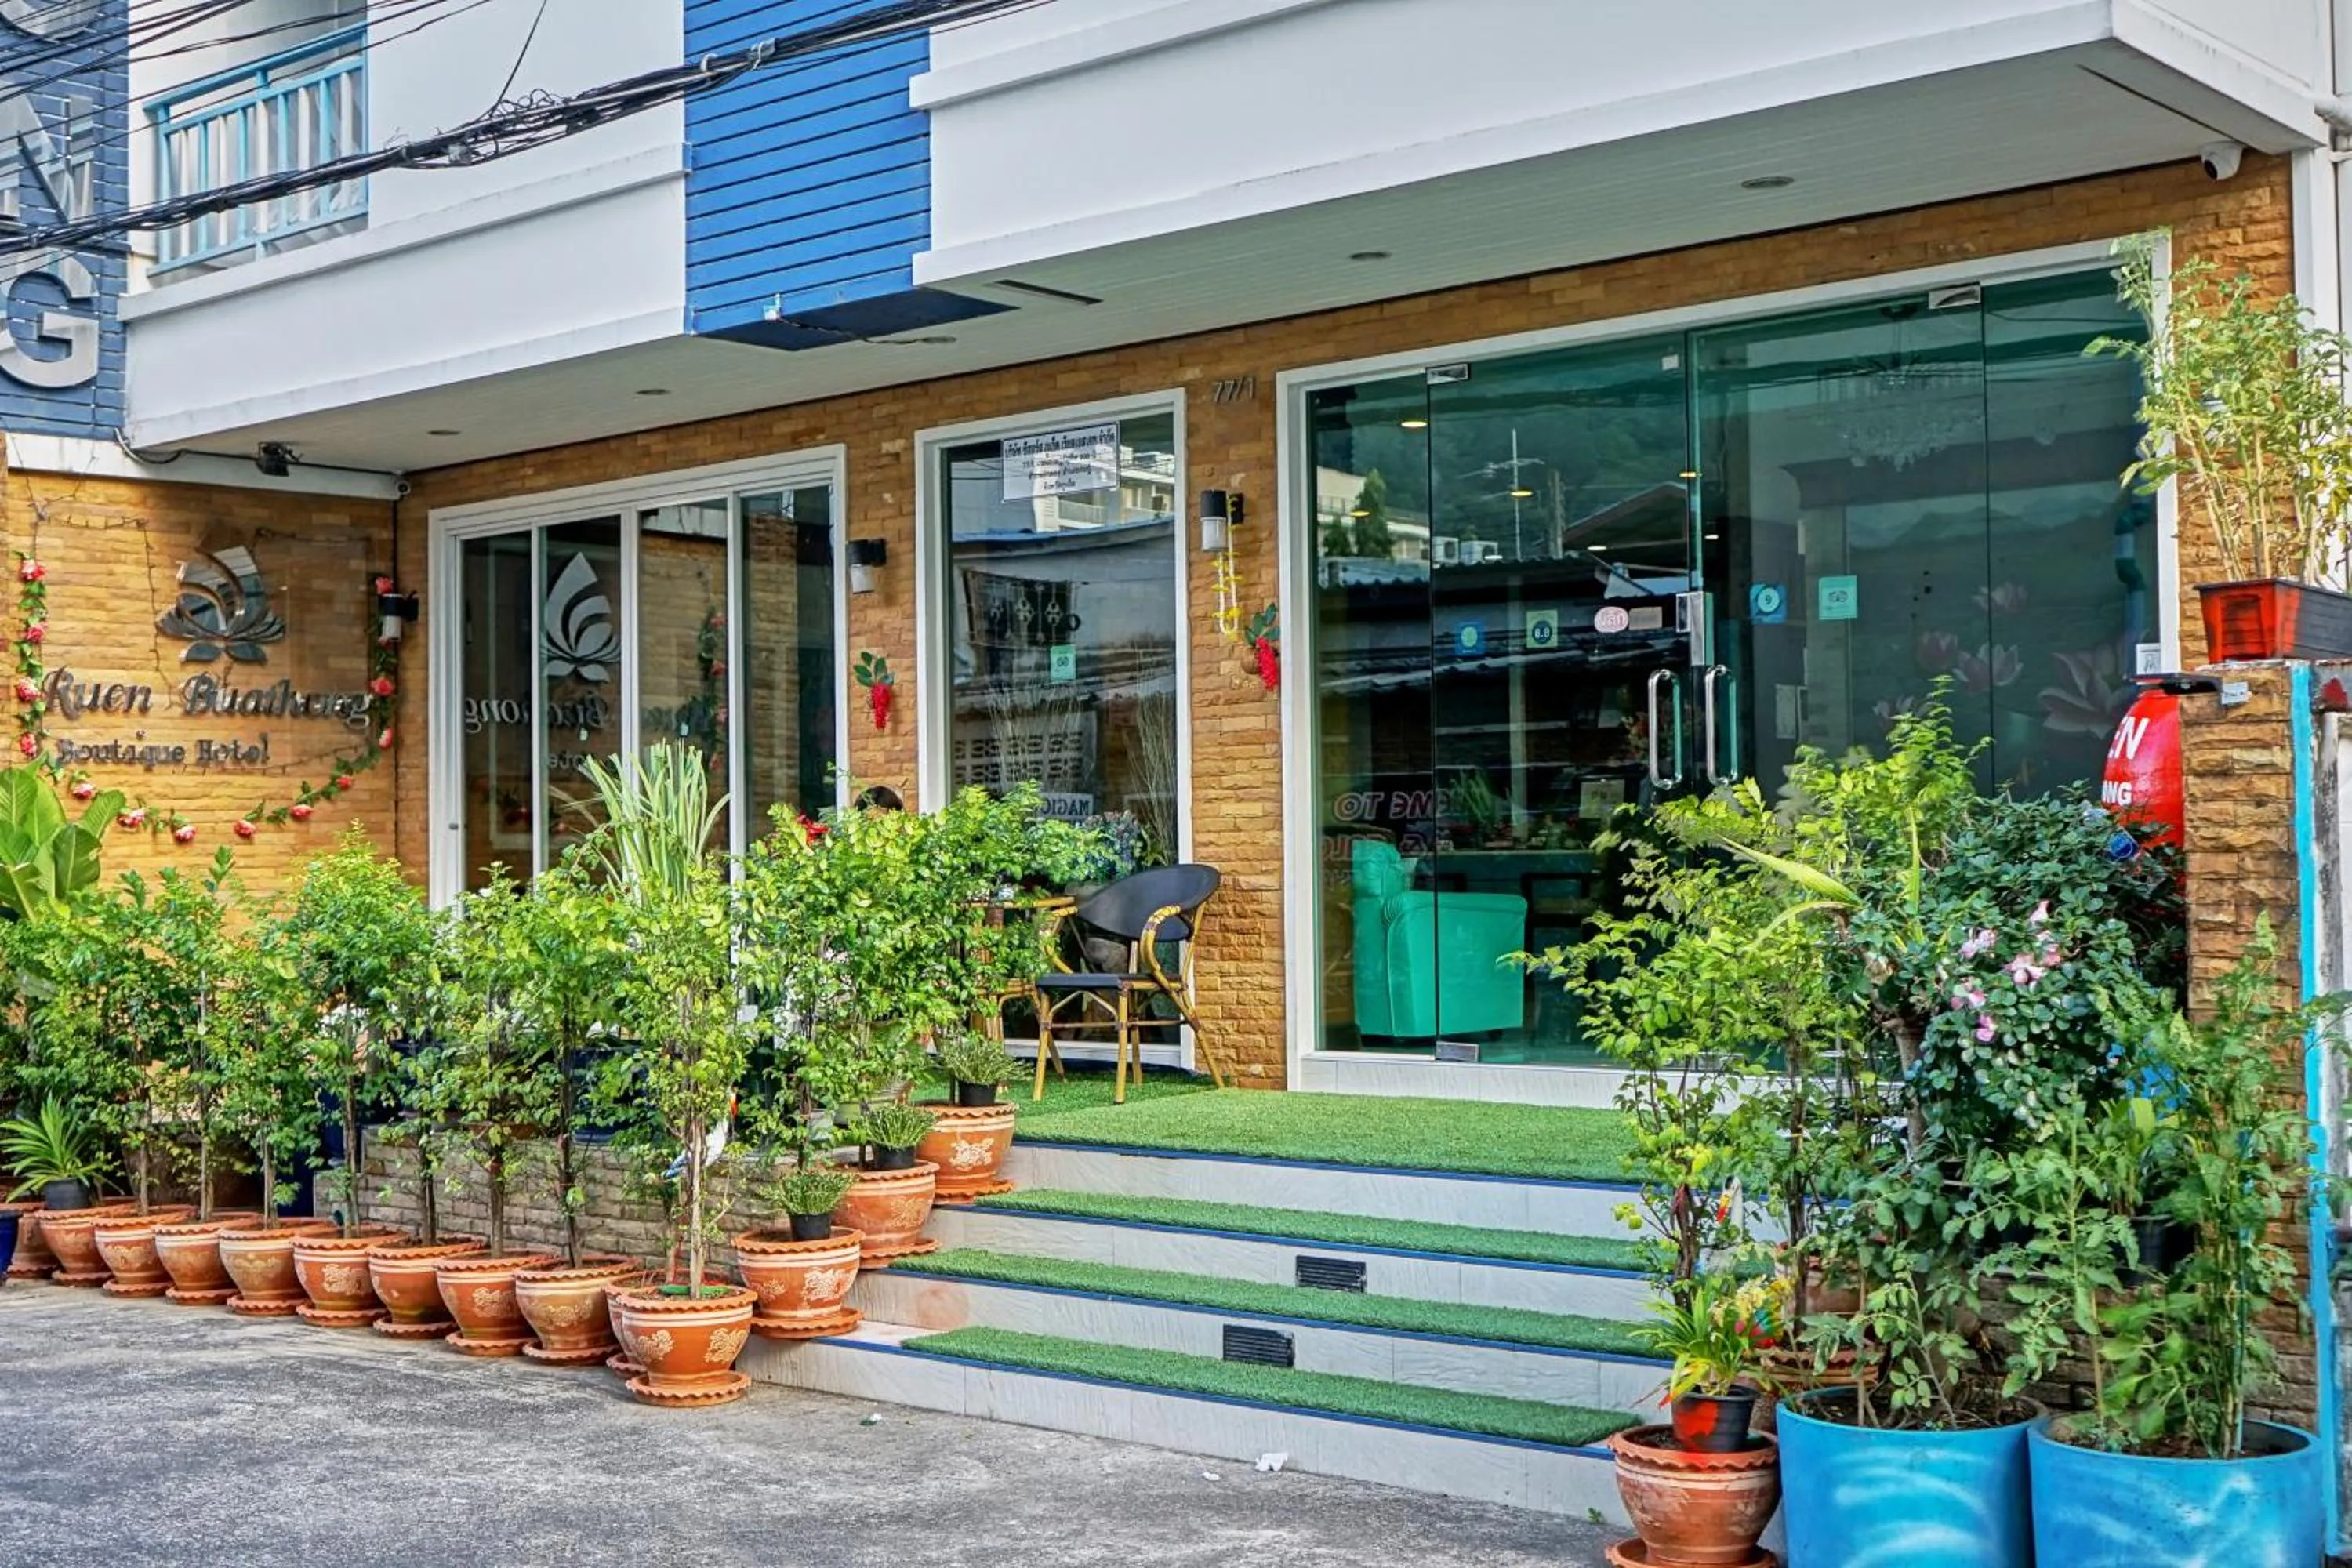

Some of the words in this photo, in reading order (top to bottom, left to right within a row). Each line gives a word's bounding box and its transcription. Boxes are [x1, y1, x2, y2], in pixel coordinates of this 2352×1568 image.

[42, 665, 151, 721] Ruen
[58, 737, 186, 772] Boutique
[196, 733, 270, 765] Hotel
